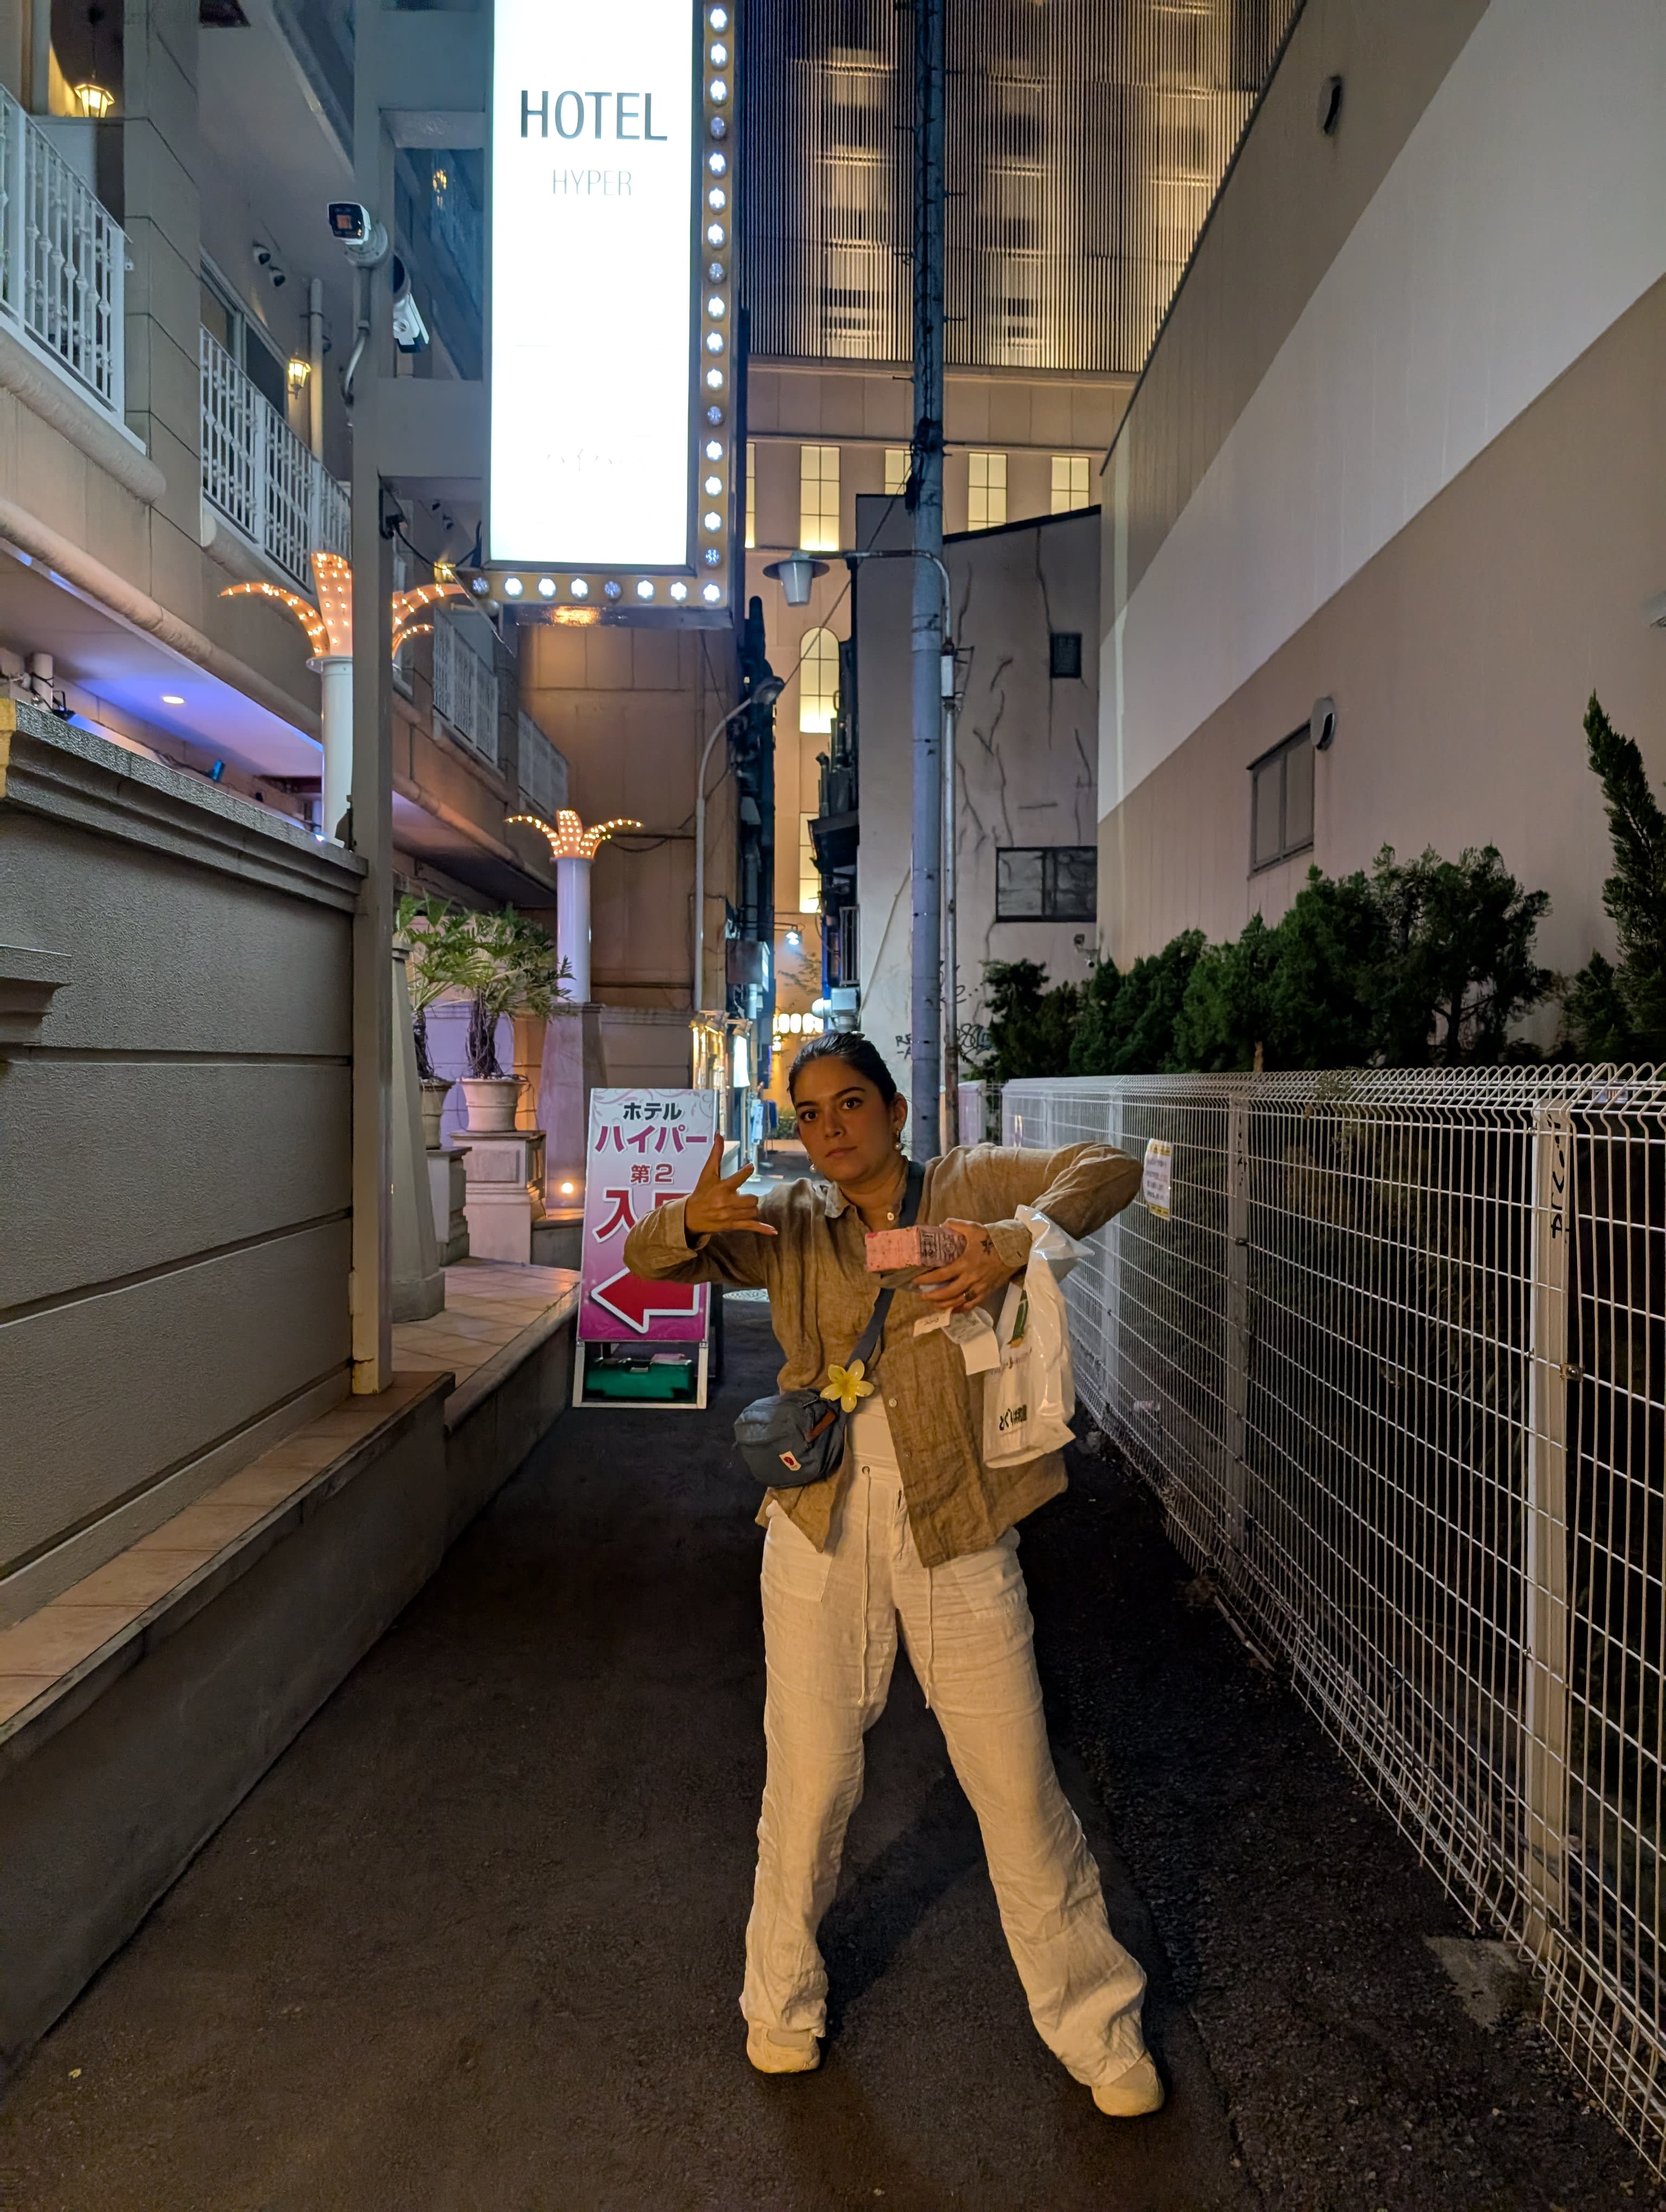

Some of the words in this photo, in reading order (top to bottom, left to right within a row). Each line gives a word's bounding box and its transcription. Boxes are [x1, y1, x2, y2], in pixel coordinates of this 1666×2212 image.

[521, 90, 668, 141] HOTEL
[553, 169, 631, 196] HYPER
[623, 1102, 682, 1121] ホテル
[595, 1124, 707, 1153] ハイパー
[630, 1164, 672, 1184] 第2
